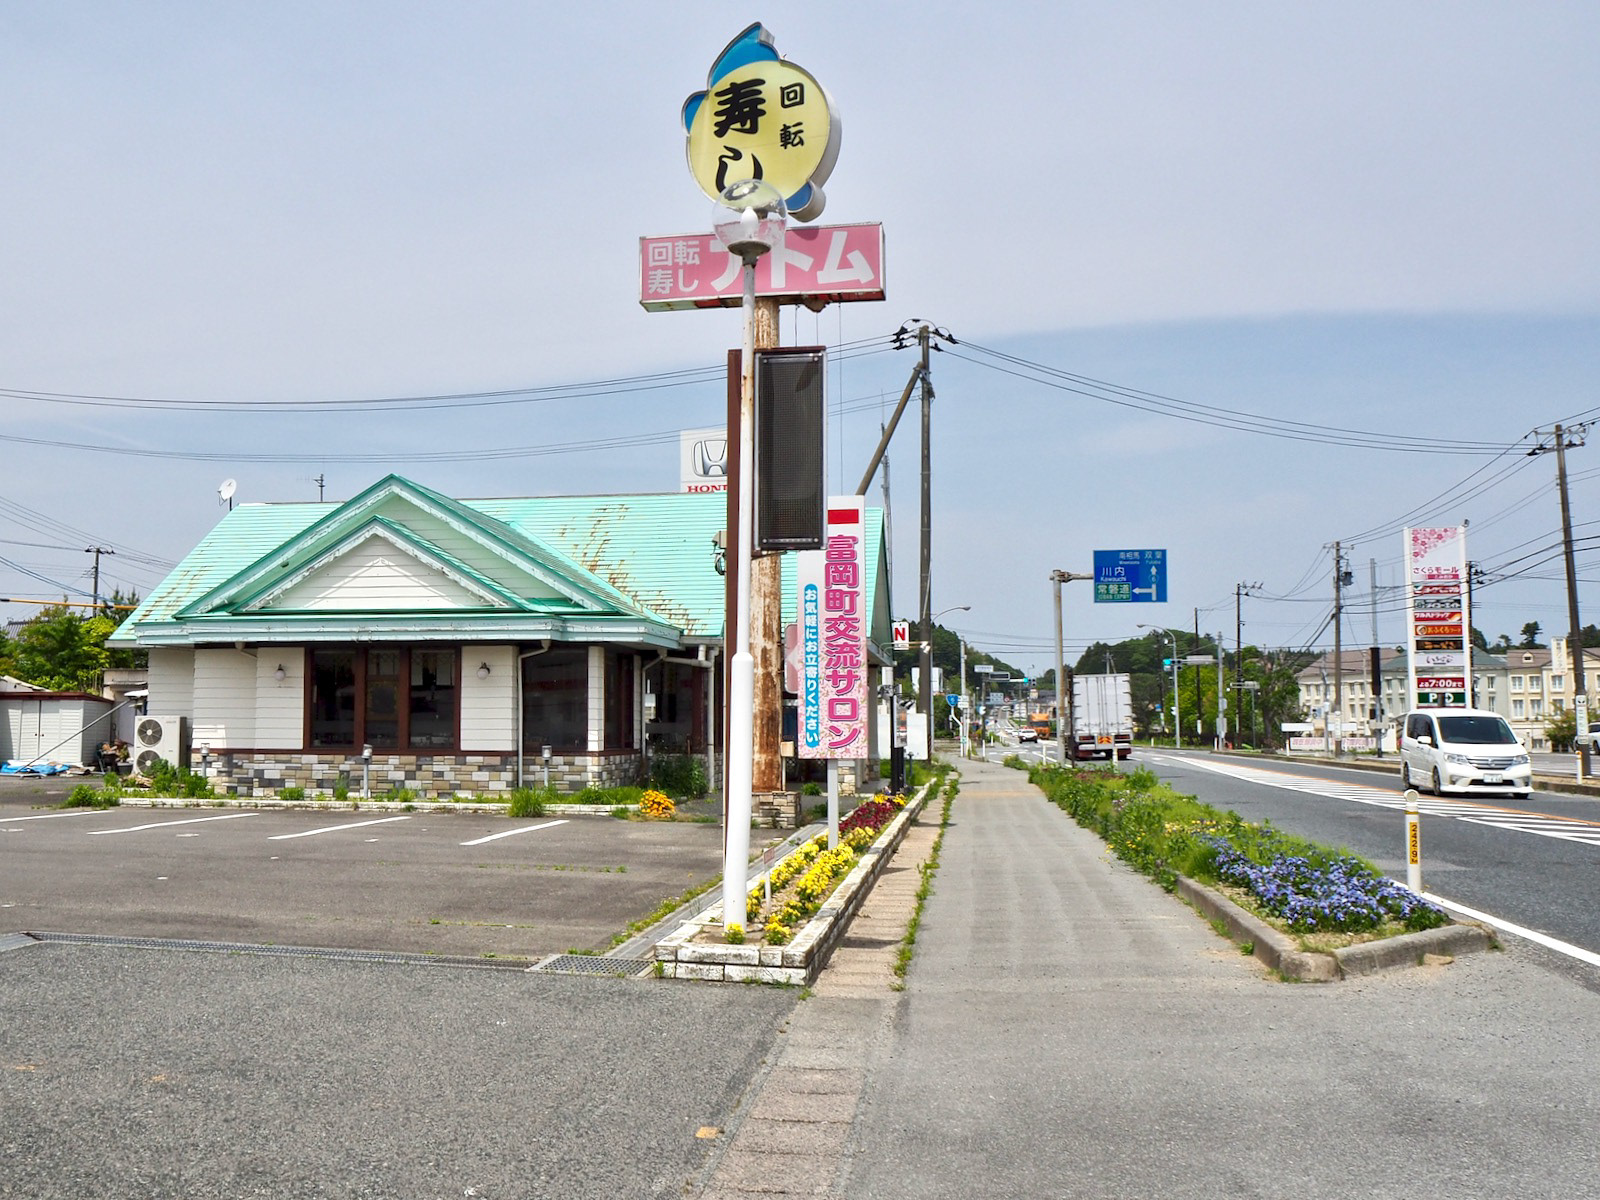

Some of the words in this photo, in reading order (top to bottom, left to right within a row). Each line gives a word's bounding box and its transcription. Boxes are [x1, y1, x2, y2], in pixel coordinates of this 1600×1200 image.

[779, 82, 805, 150] 回転
[649, 240, 700, 267] 回転
[648, 268, 699, 295] 寿し
[1101, 566, 1125, 577] 川内
[1413, 566, 1458, 574] さくらモール
[824, 534, 861, 750] 富岡町交流サロン
[894, 627, 905, 641] N
[805, 588, 819, 743] お気軽にお立寄りください
[1429, 693, 1438, 703] P
